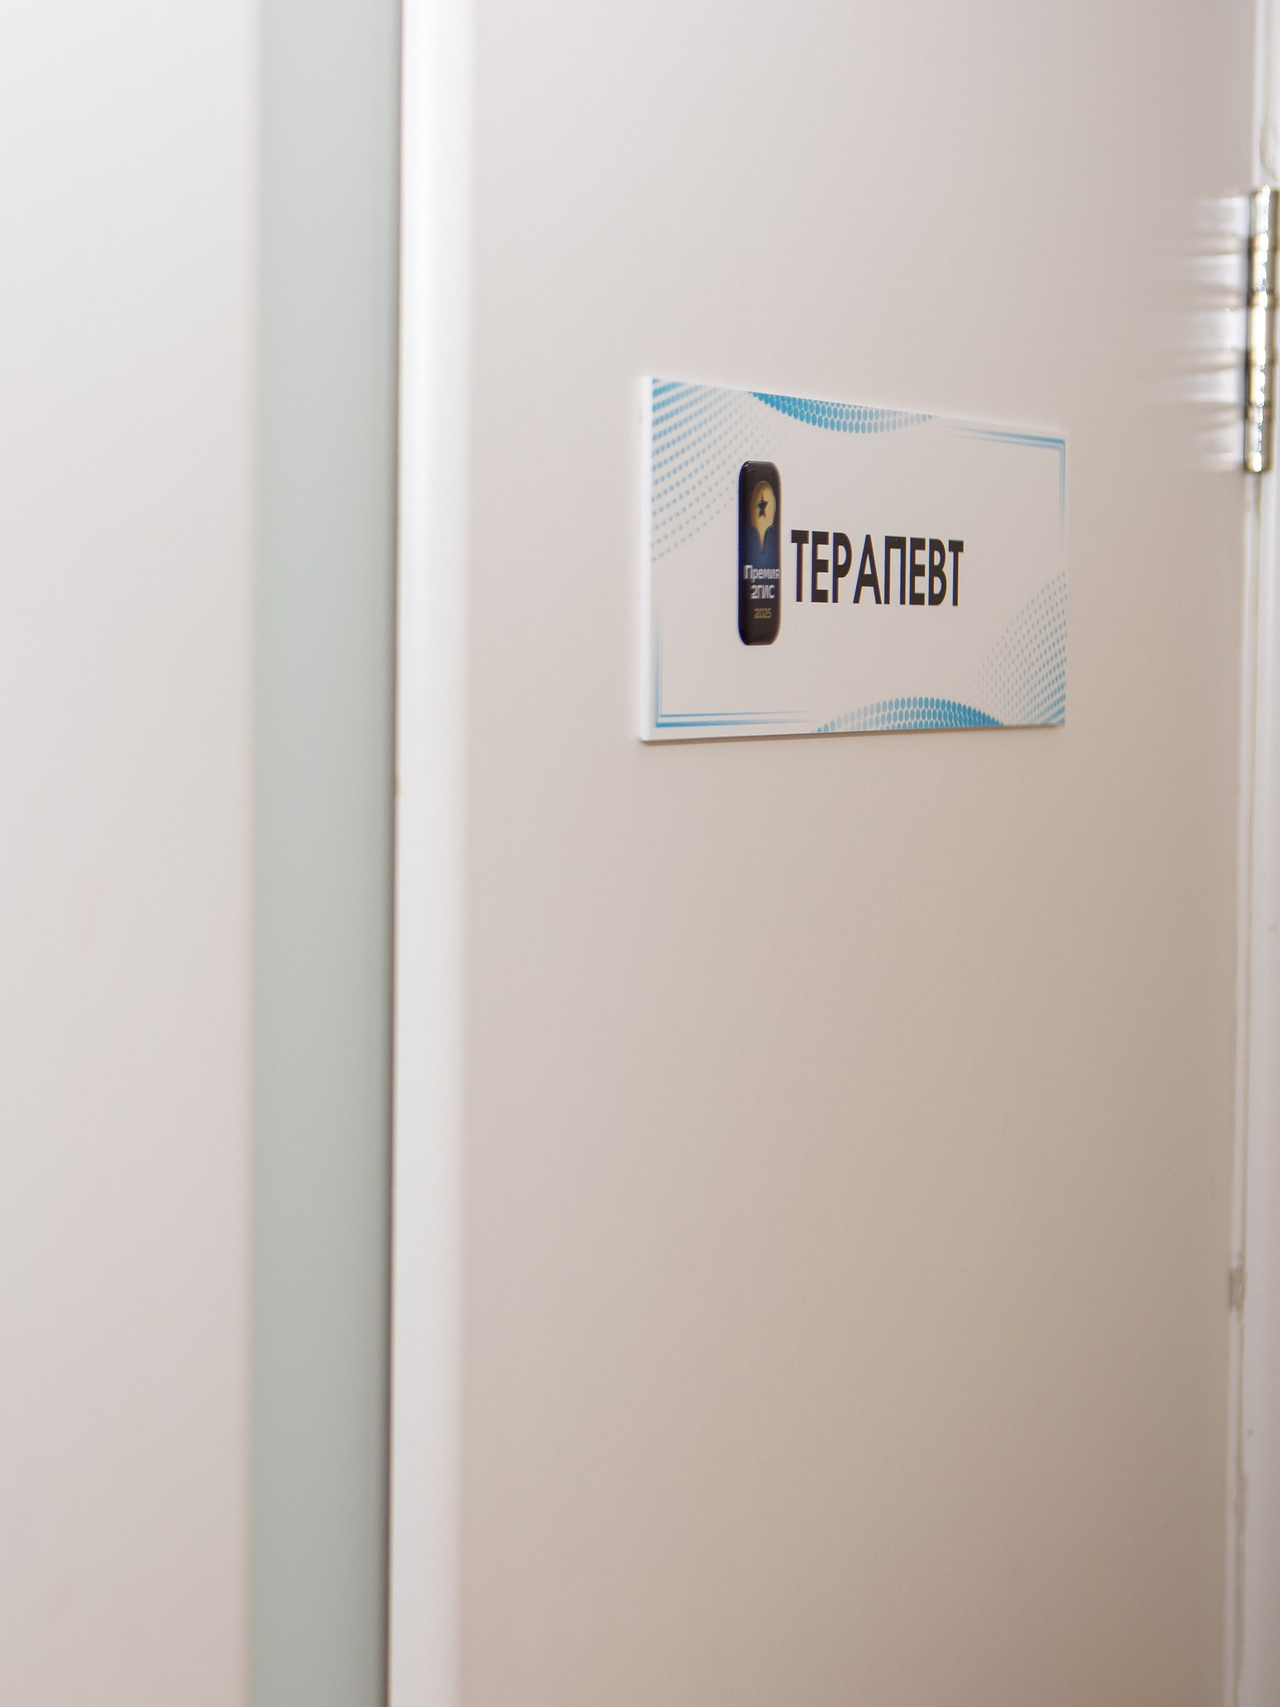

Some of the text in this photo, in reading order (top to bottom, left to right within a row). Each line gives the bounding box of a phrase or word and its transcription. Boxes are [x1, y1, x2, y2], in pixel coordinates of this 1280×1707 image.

[744, 565, 780, 583] Премия
[791, 529, 964, 607] ТЕРАПЕВТ
[750, 585, 775, 599] 2ГИС
[754, 608, 772, 619] 2025
